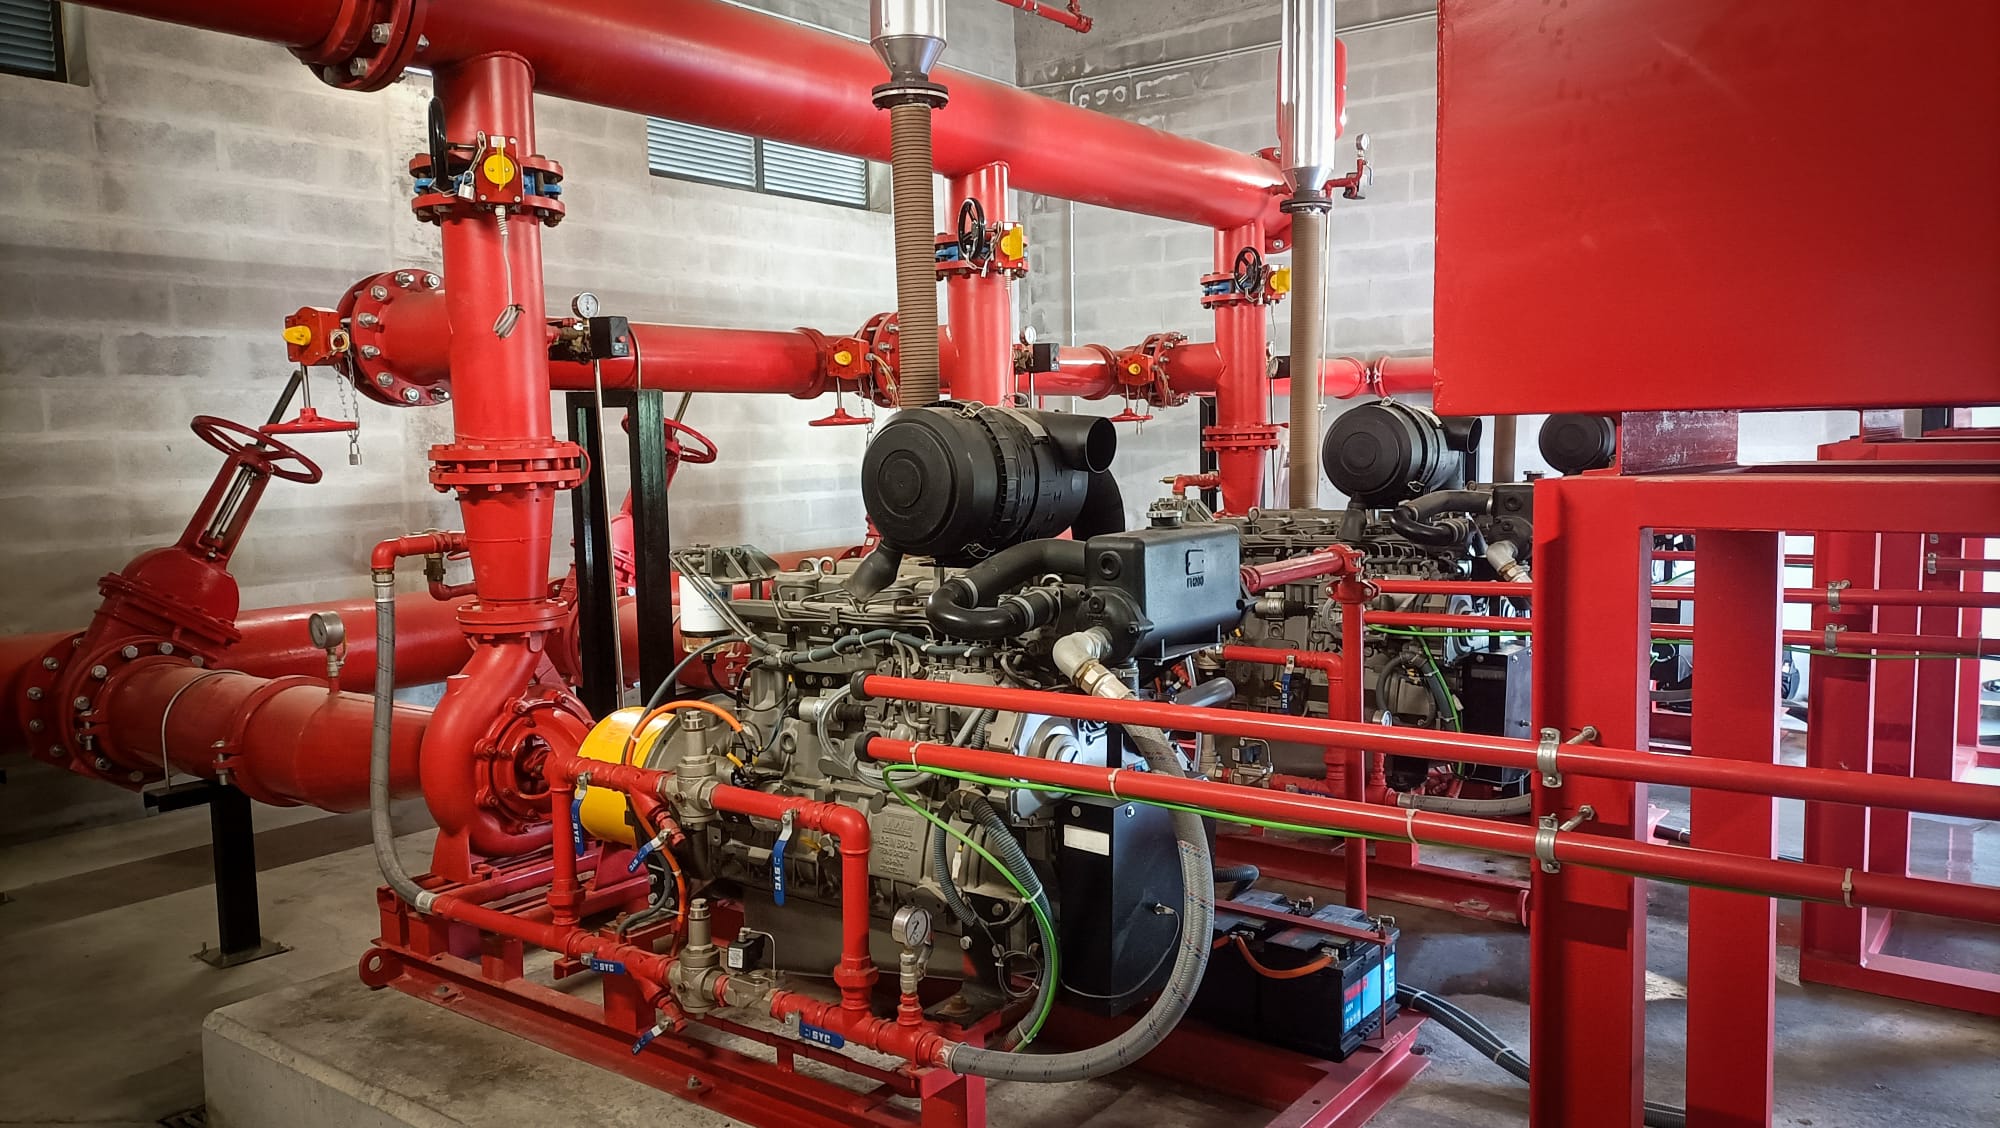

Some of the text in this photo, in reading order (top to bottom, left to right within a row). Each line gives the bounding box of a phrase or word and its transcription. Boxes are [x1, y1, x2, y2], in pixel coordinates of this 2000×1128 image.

[572, 822, 580, 843] SYC
[774, 866, 782, 891] SYC
[599, 963, 615, 972] SYC
[811, 1030, 831, 1044] SYC
